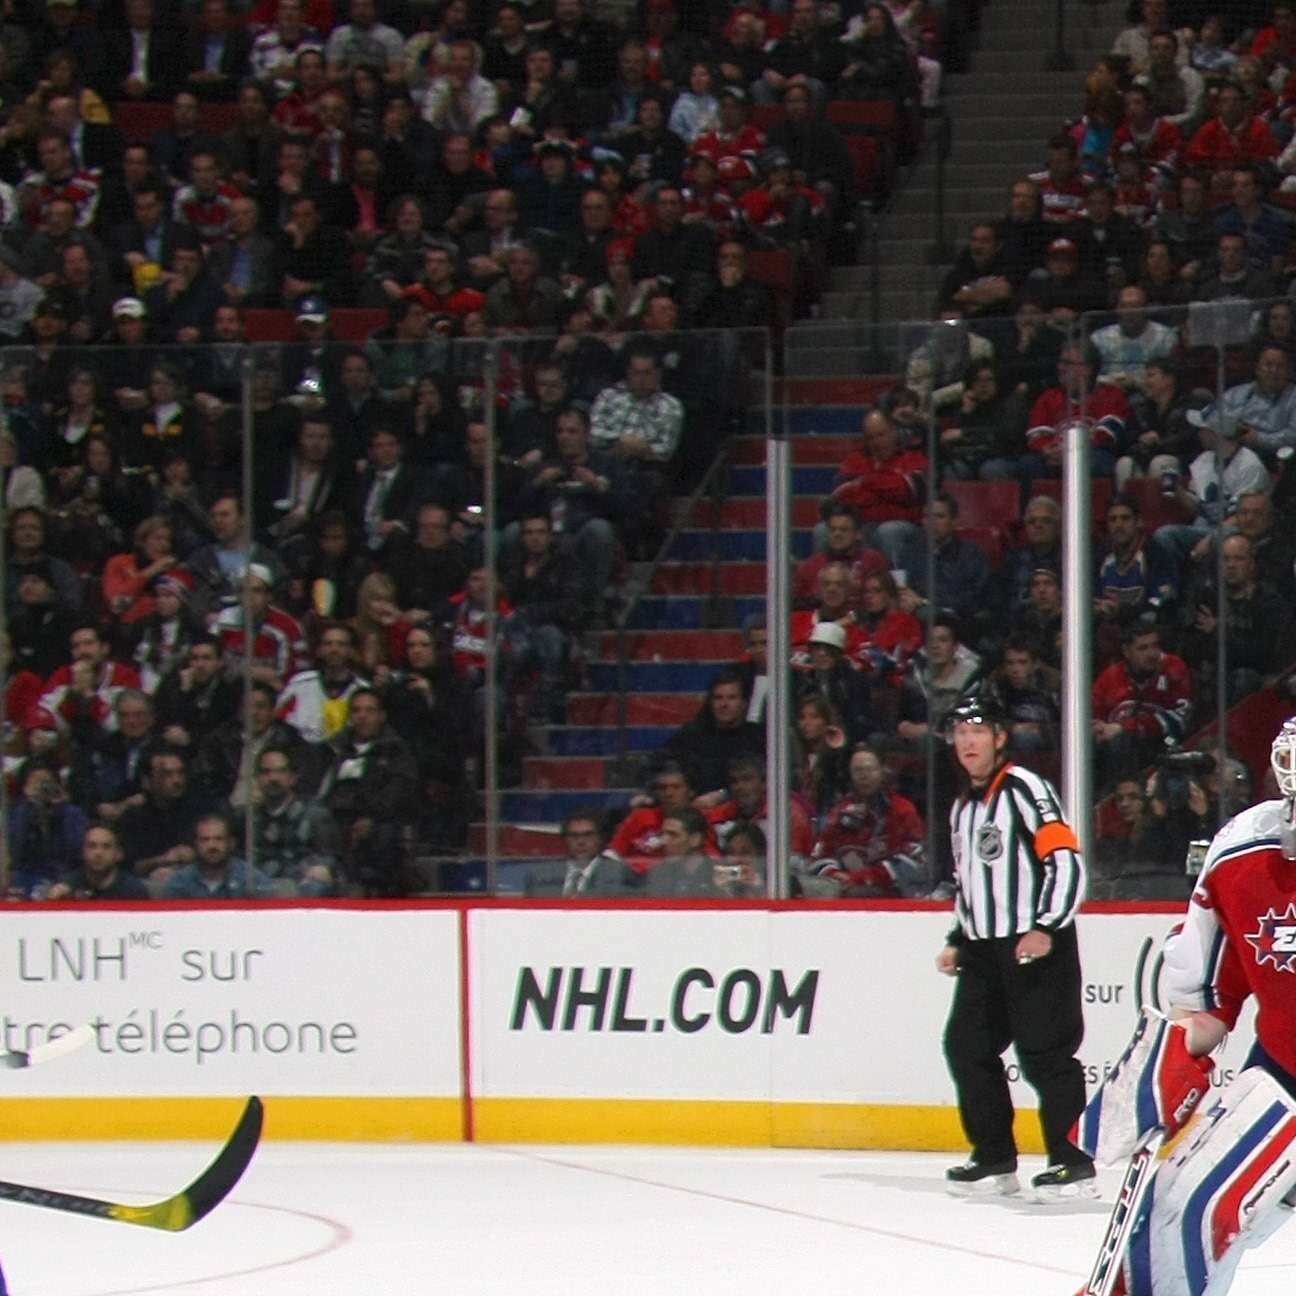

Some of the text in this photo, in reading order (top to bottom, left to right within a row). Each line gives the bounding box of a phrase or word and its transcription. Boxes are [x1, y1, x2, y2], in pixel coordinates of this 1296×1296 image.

[180, 949, 263, 981] sur
[508, 966, 820, 1035] NHL.COM
[1085, 984, 1123, 1003] sur
[95, 1008, 357, 1064] téléphone
